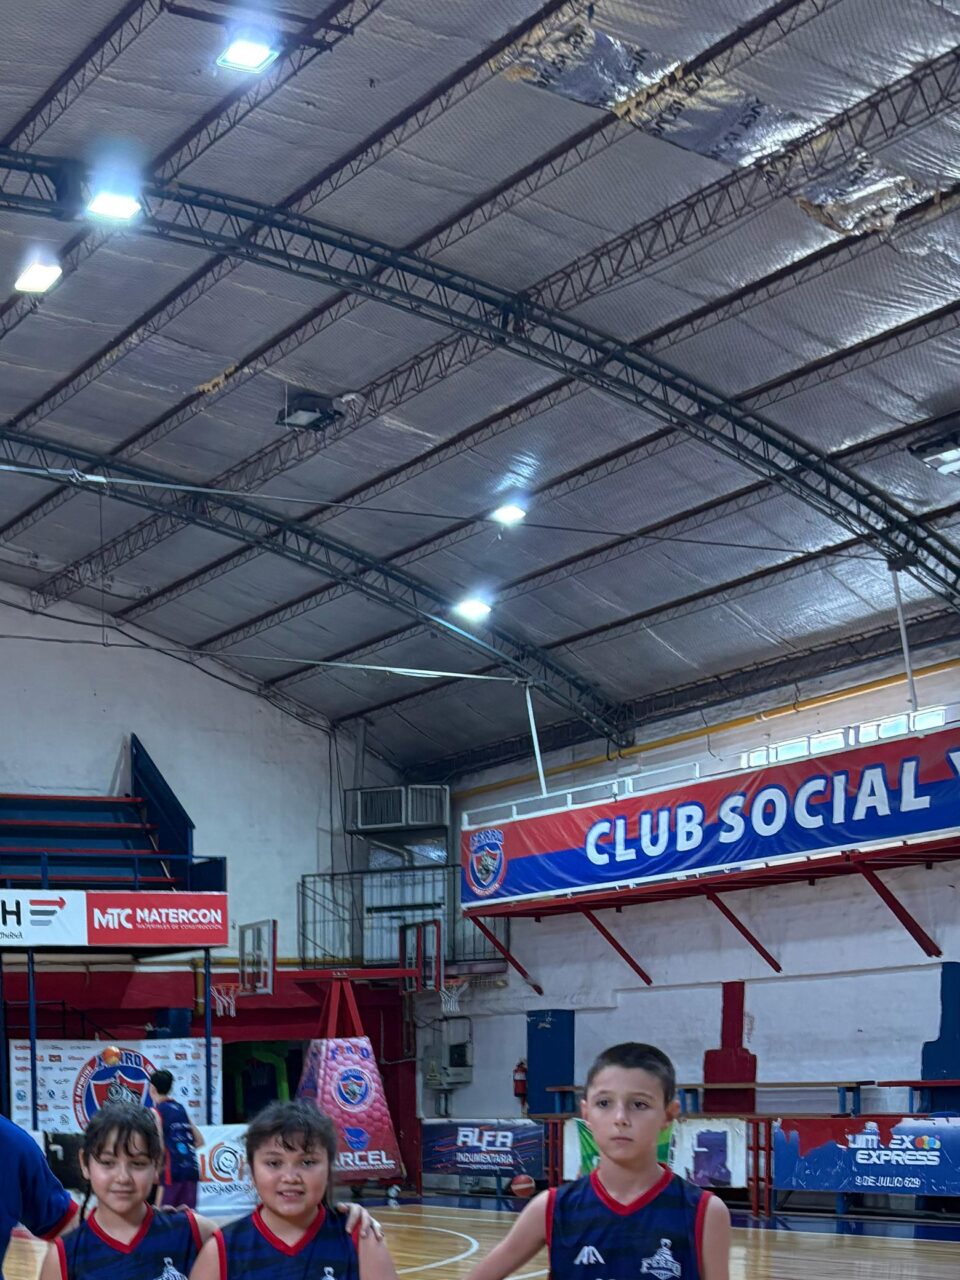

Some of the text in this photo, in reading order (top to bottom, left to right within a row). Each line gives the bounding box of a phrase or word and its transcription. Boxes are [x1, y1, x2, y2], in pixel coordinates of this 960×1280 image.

[585, 760, 931, 865] CLUB SOCIAL
[93, 908, 132, 929] MTC
[136, 908, 222, 924] MATERCON
[457, 1127, 513, 1151] ALFA
[856, 1150, 940, 1165] EXPRESS
[863, 1176, 876, 1186] DE
[877, 1177, 903, 1187] JULIO
